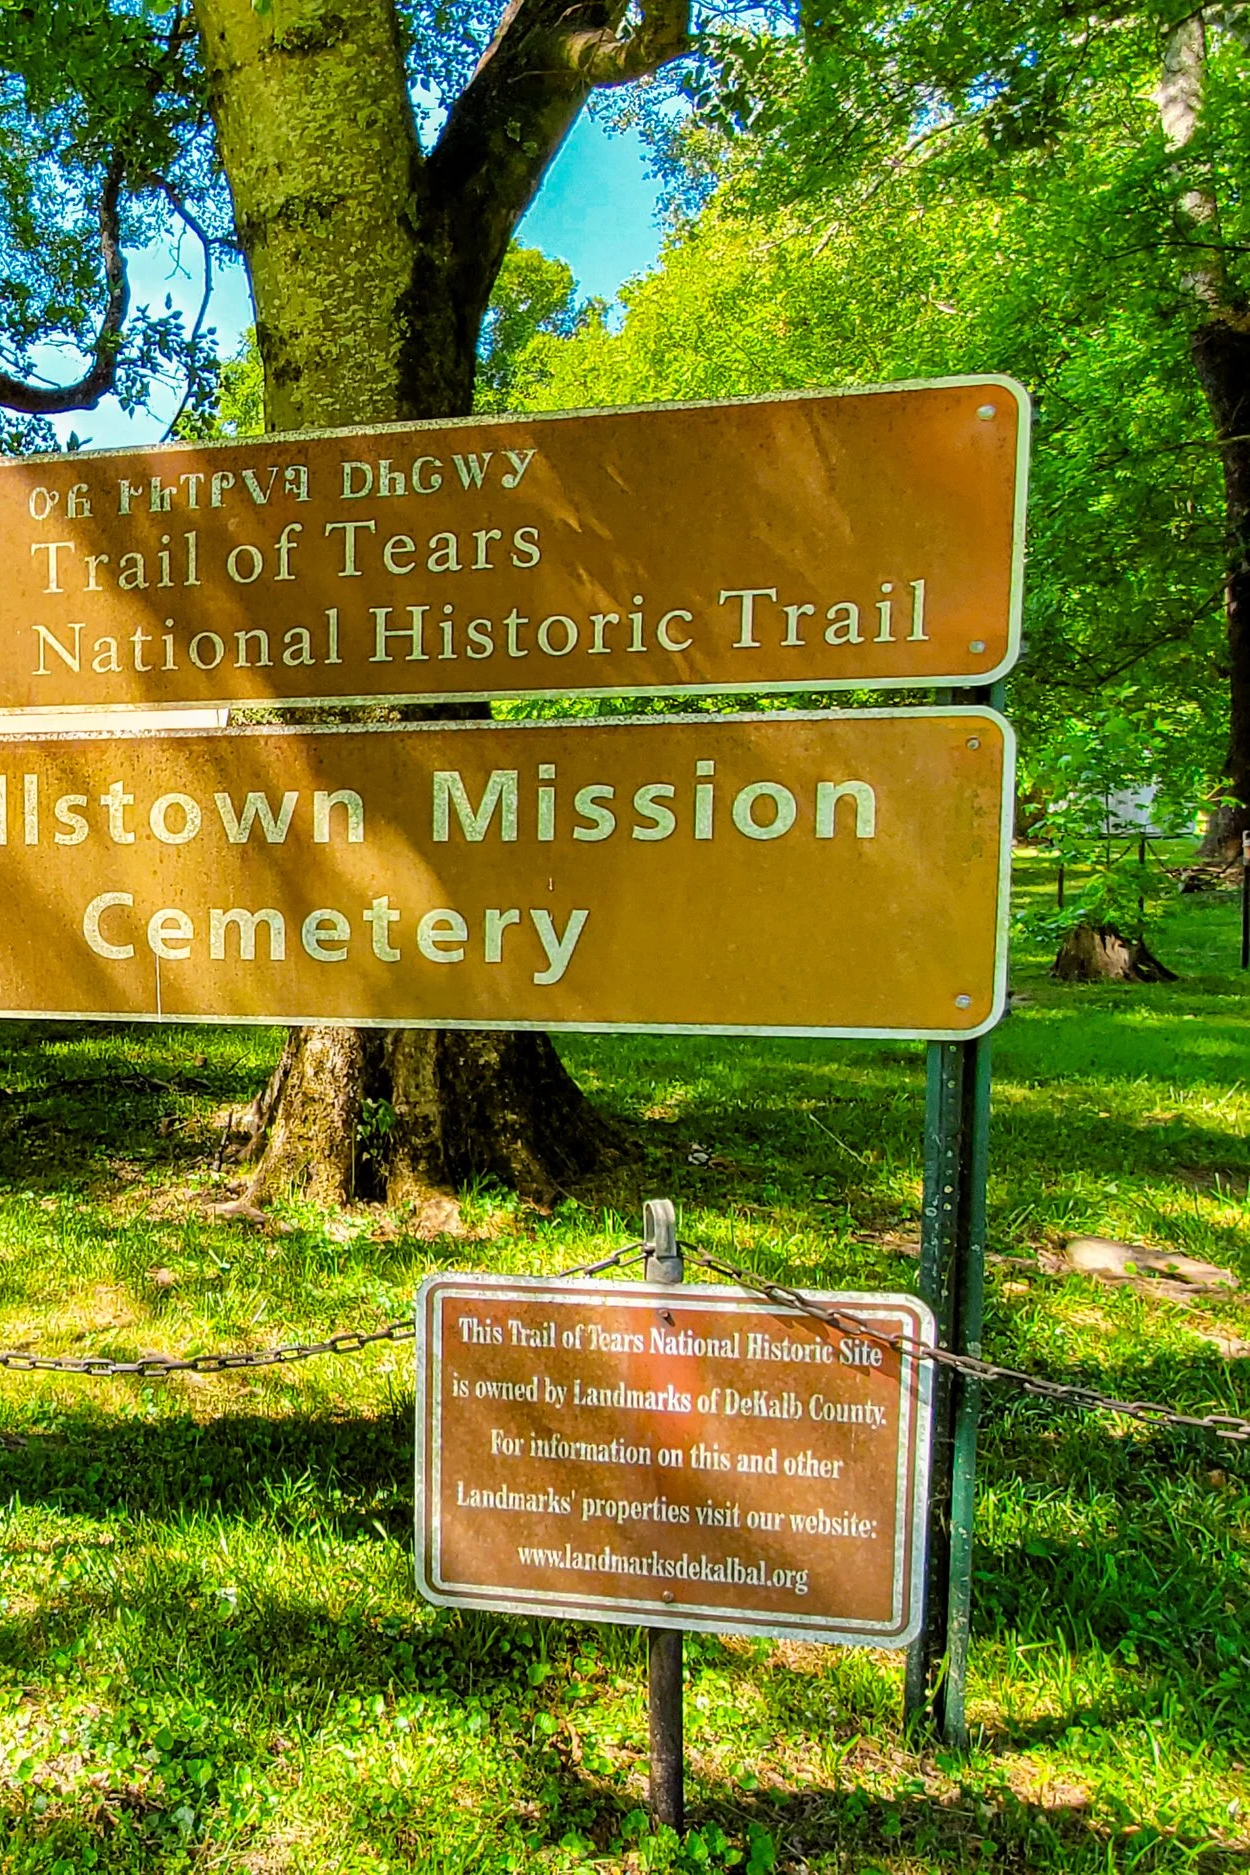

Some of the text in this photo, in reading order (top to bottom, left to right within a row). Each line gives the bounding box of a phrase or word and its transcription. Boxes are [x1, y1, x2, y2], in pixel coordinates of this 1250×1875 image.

[31, 520, 542, 594] Trail of Tears
[31, 579, 929, 676] National Historic Trail
[432, 761, 878, 842] Mission
[83, 891, 590, 985] Cemetery
[459, 1318, 883, 1367] This Trail of Tears National Historic Site
[452, 1372, 887, 1428] is owned by Landmarks of DeKalb County.
[490, 1429, 843, 1479] For information on this and other
[457, 1481, 878, 1539] Landmarks' properties visit our website:
[518, 1544, 808, 1595] www.landmarksdekalbal.org
